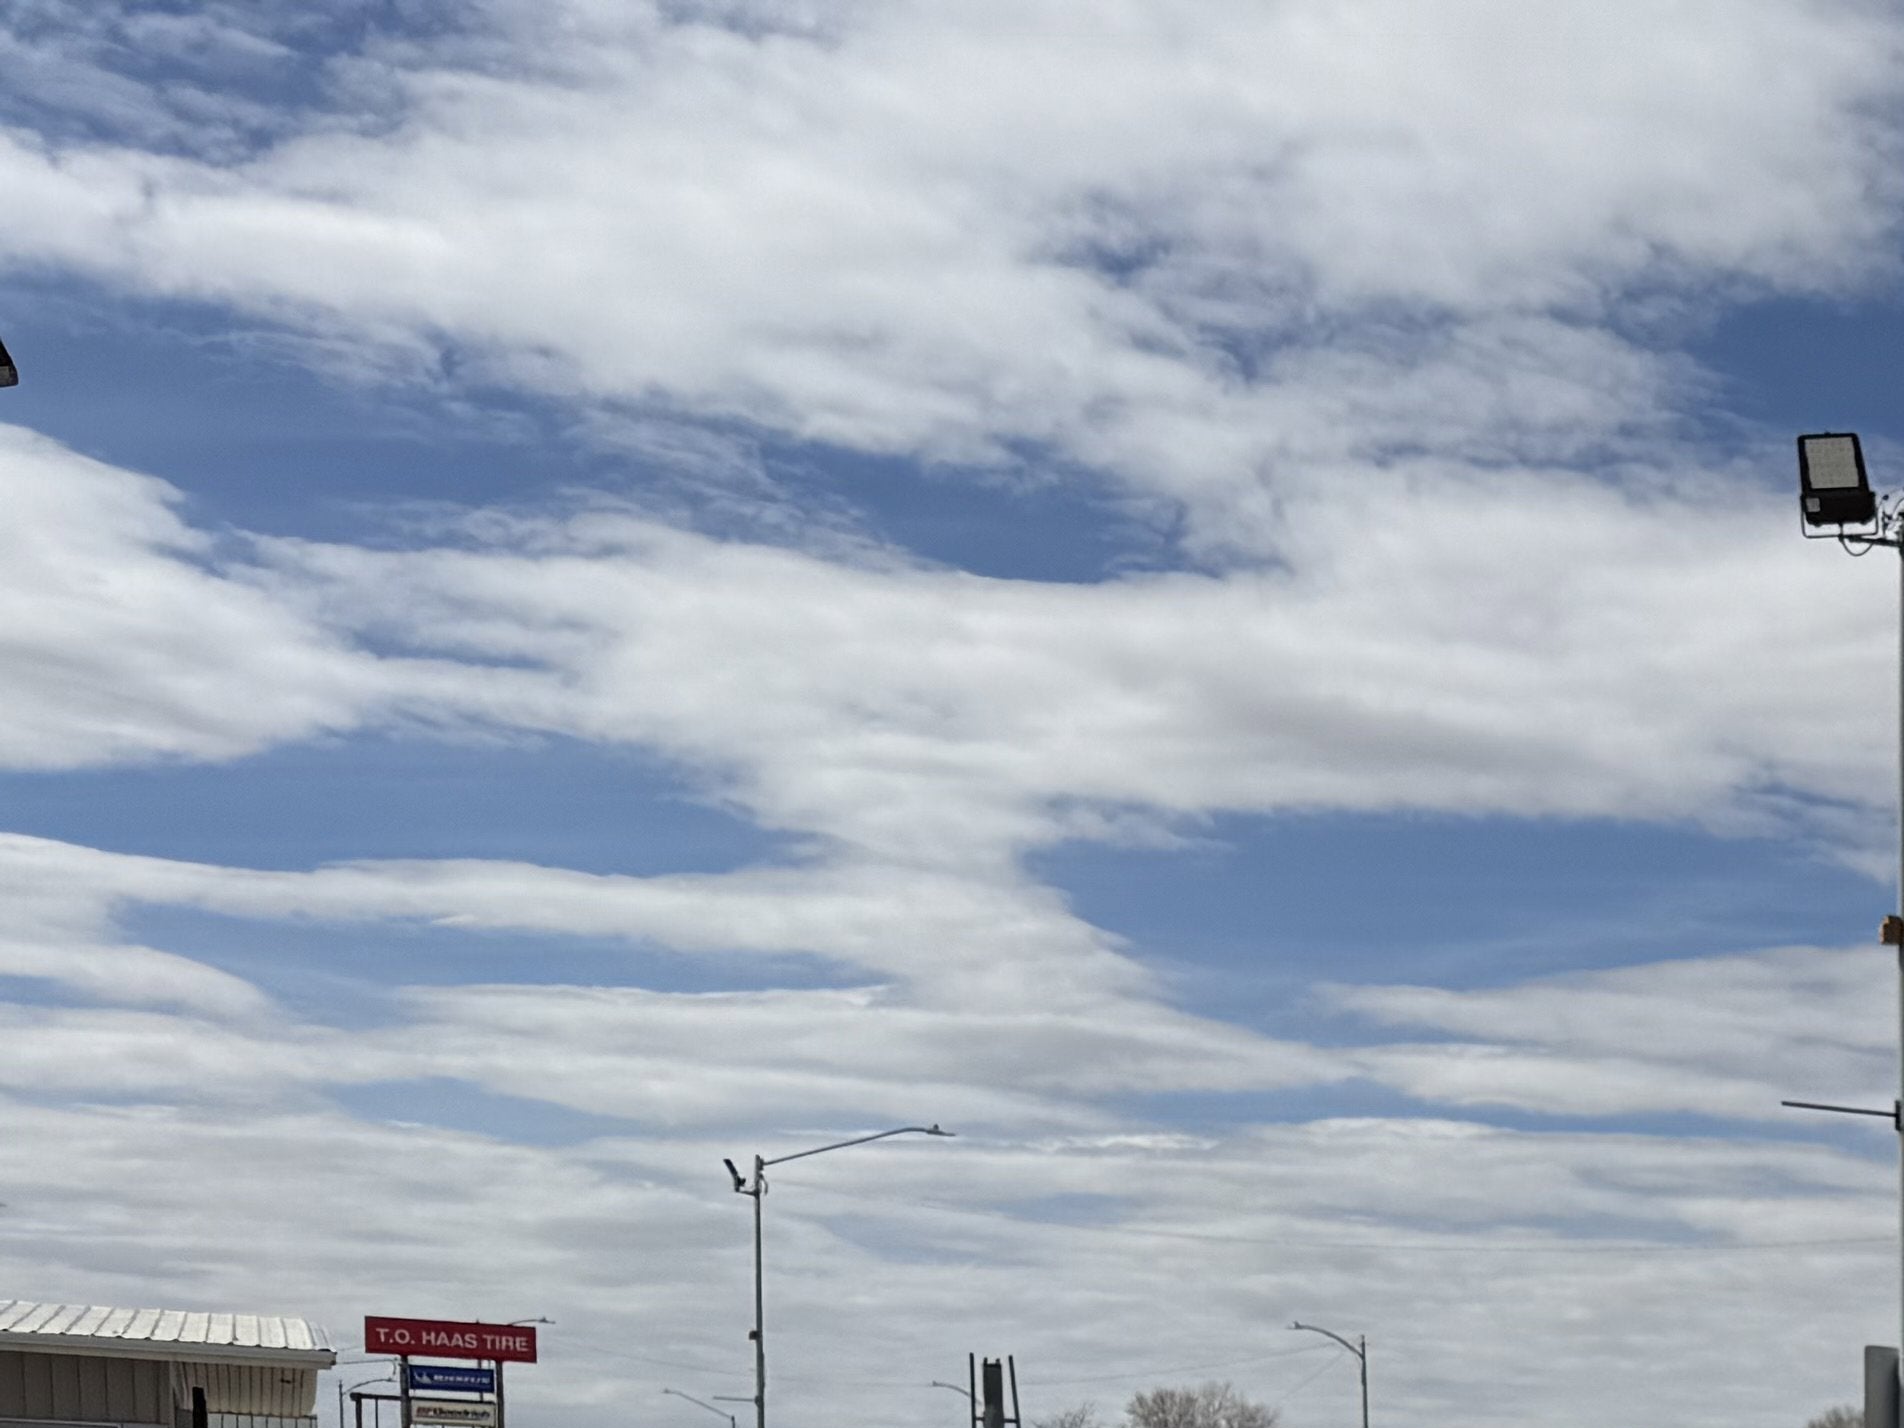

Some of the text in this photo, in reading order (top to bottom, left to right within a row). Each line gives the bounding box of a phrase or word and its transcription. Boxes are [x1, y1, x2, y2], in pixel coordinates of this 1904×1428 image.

[375, 1327, 529, 1352] T.O. HAAS TIRE
